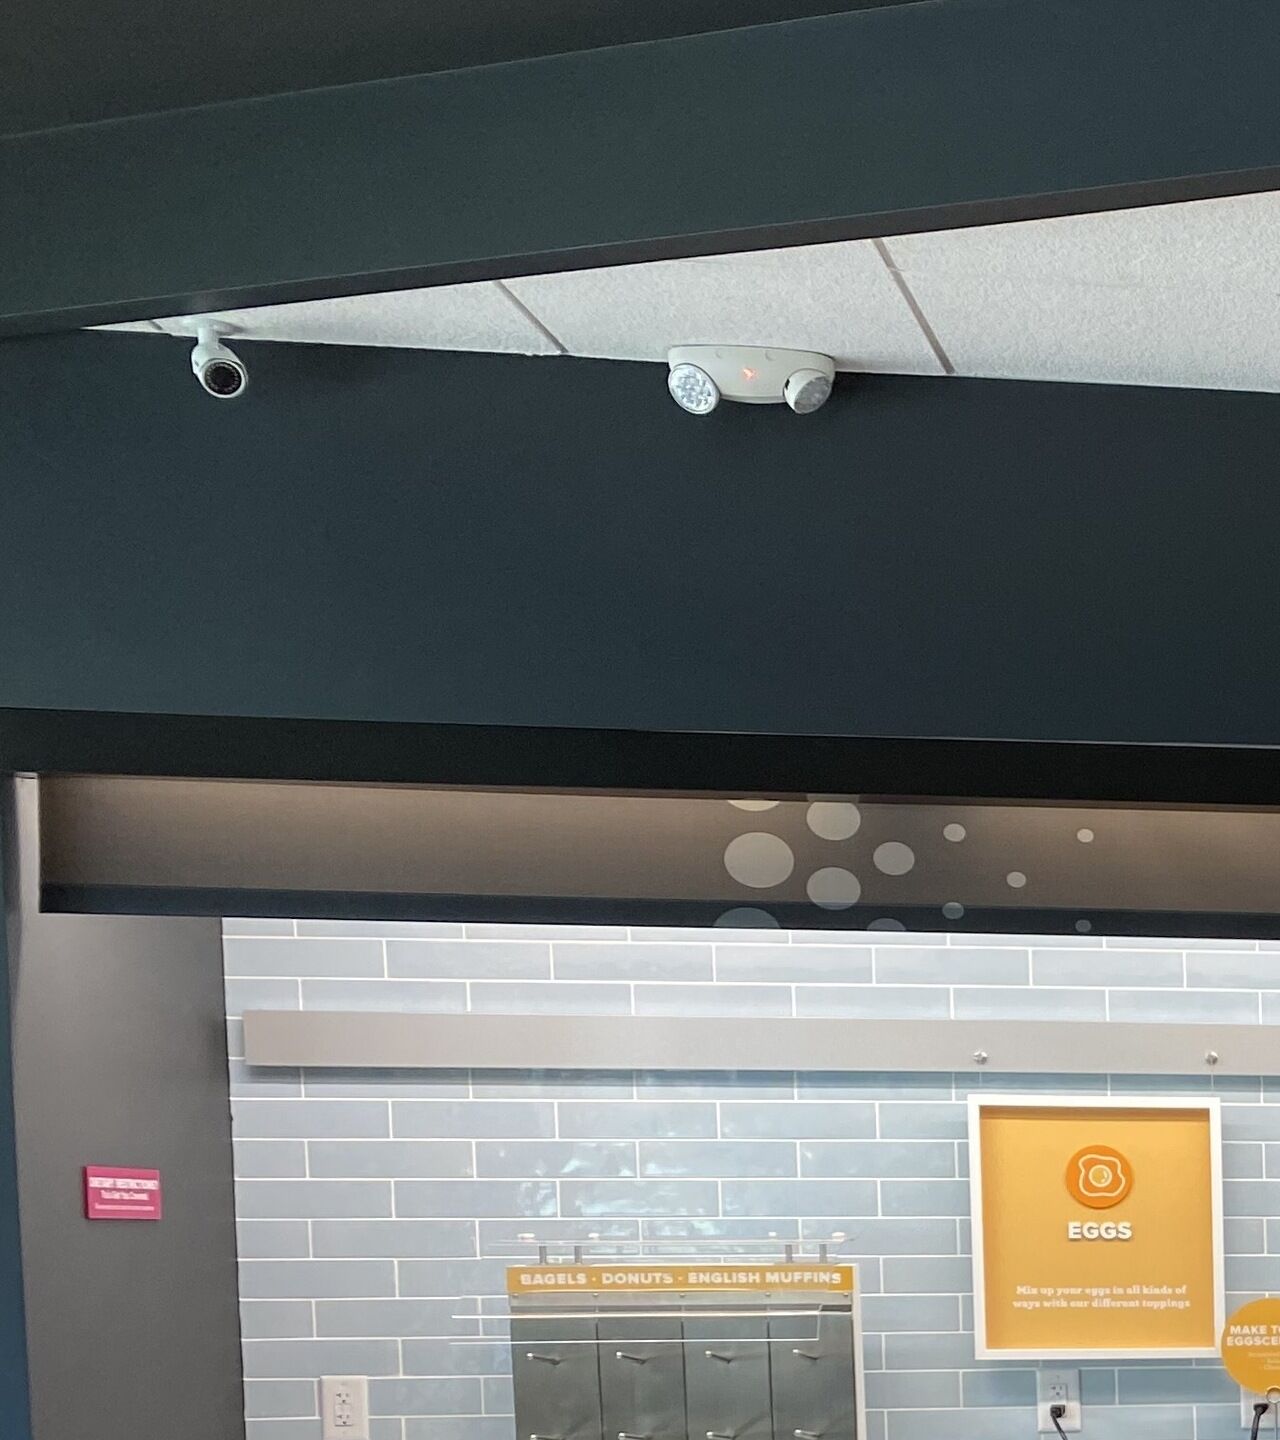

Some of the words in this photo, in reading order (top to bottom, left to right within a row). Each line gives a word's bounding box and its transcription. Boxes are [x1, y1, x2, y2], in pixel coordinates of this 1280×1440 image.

[1068, 1221, 1133, 1240] EGGS
[520, 1272, 587, 1285] BAGELS
[601, 1272, 673, 1284] DONUTS
[687, 1272, 760, 1284] ENGLISH
[765, 1272, 842, 1284] MUFFINS
[1016, 1285, 1037, 1294] Mix
[1040, 1287, 1053, 1297] up
[1053, 1287, 1081, 1297] your
[1085, 1287, 1111, 1297] eggs
[1113, 1285, 1124, 1294] in
[1126, 1285, 1140, 1294] all
[1142, 1285, 1173, 1294] kinds
[1175, 1285, 1187, 1294] of
[1013, 1300, 1040, 1309] ways
[1043, 1299, 1068, 1308] with
[1092, 1299, 1140, 1308] different
[1142, 1299, 1190, 1310] toppings
[1229, 1325, 1267, 1335] MAKE
